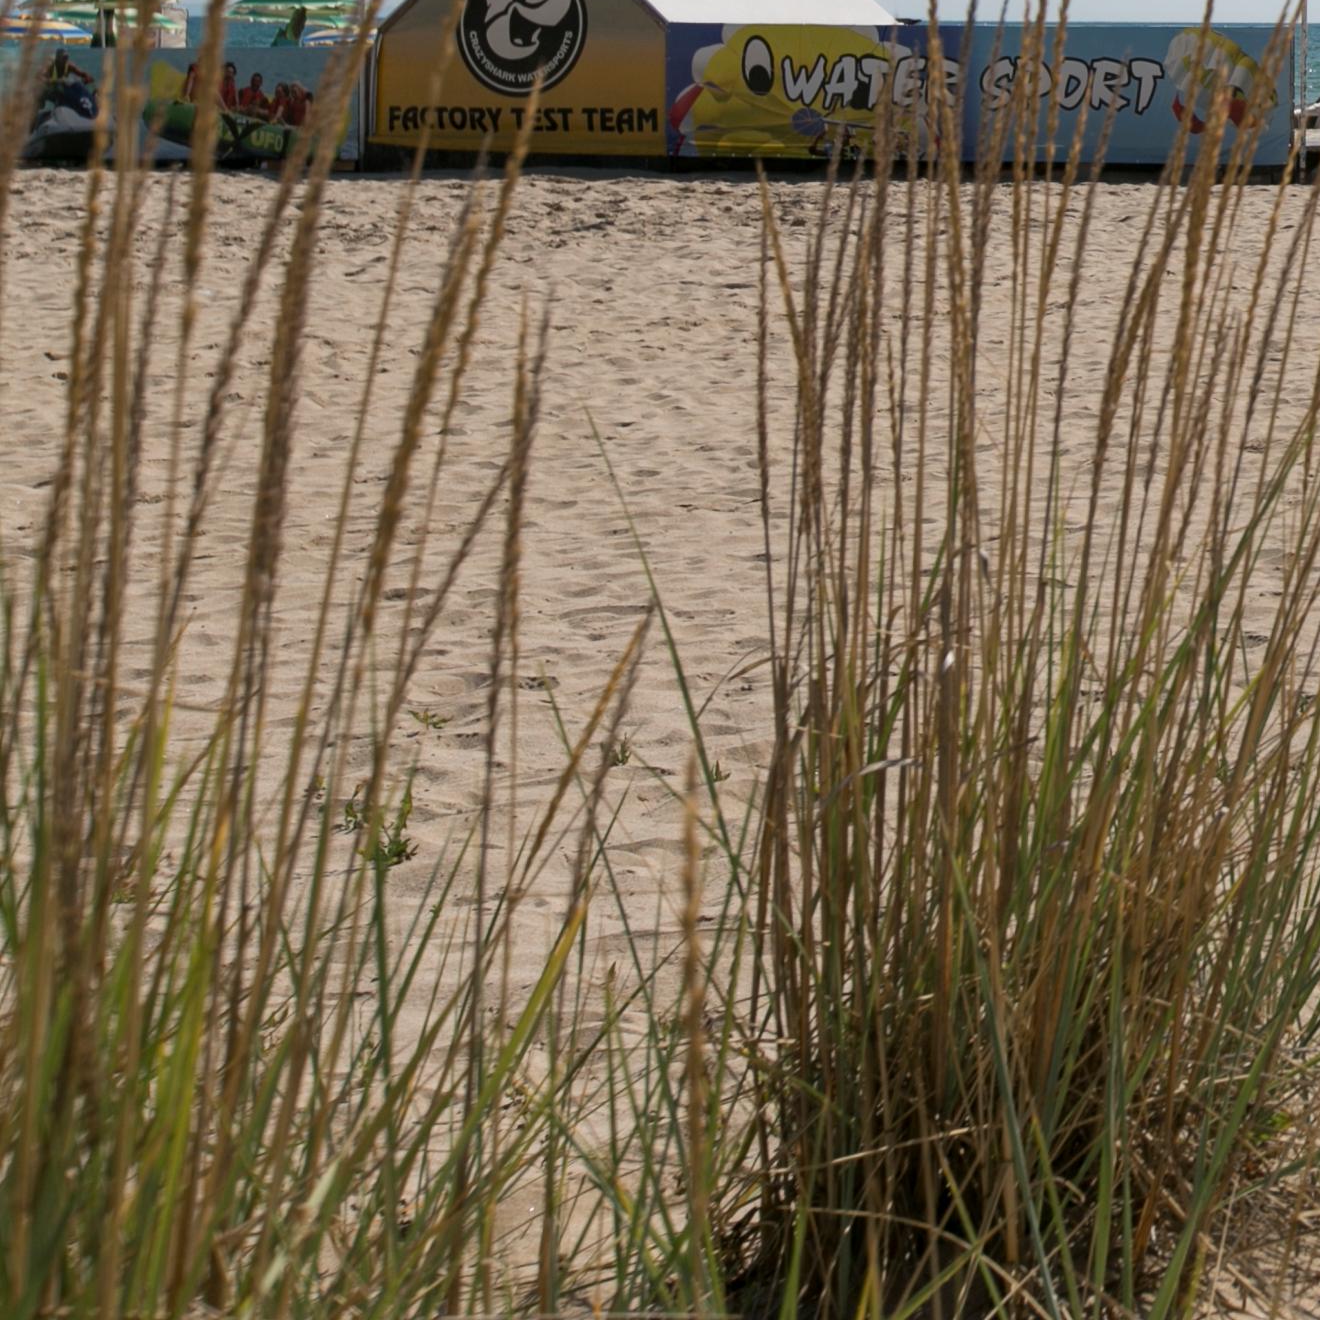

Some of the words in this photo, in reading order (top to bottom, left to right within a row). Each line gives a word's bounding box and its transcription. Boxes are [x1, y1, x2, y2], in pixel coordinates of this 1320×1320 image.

[469, 30, 516, 83] CRAZYSHARK
[979, 56, 1164, 115] SPORT
[388, 105, 502, 132] FACTORY
[510, 107, 573, 131] TEST
[581, 107, 658, 134] TEAM
[251, 128, 284, 153] UFO
